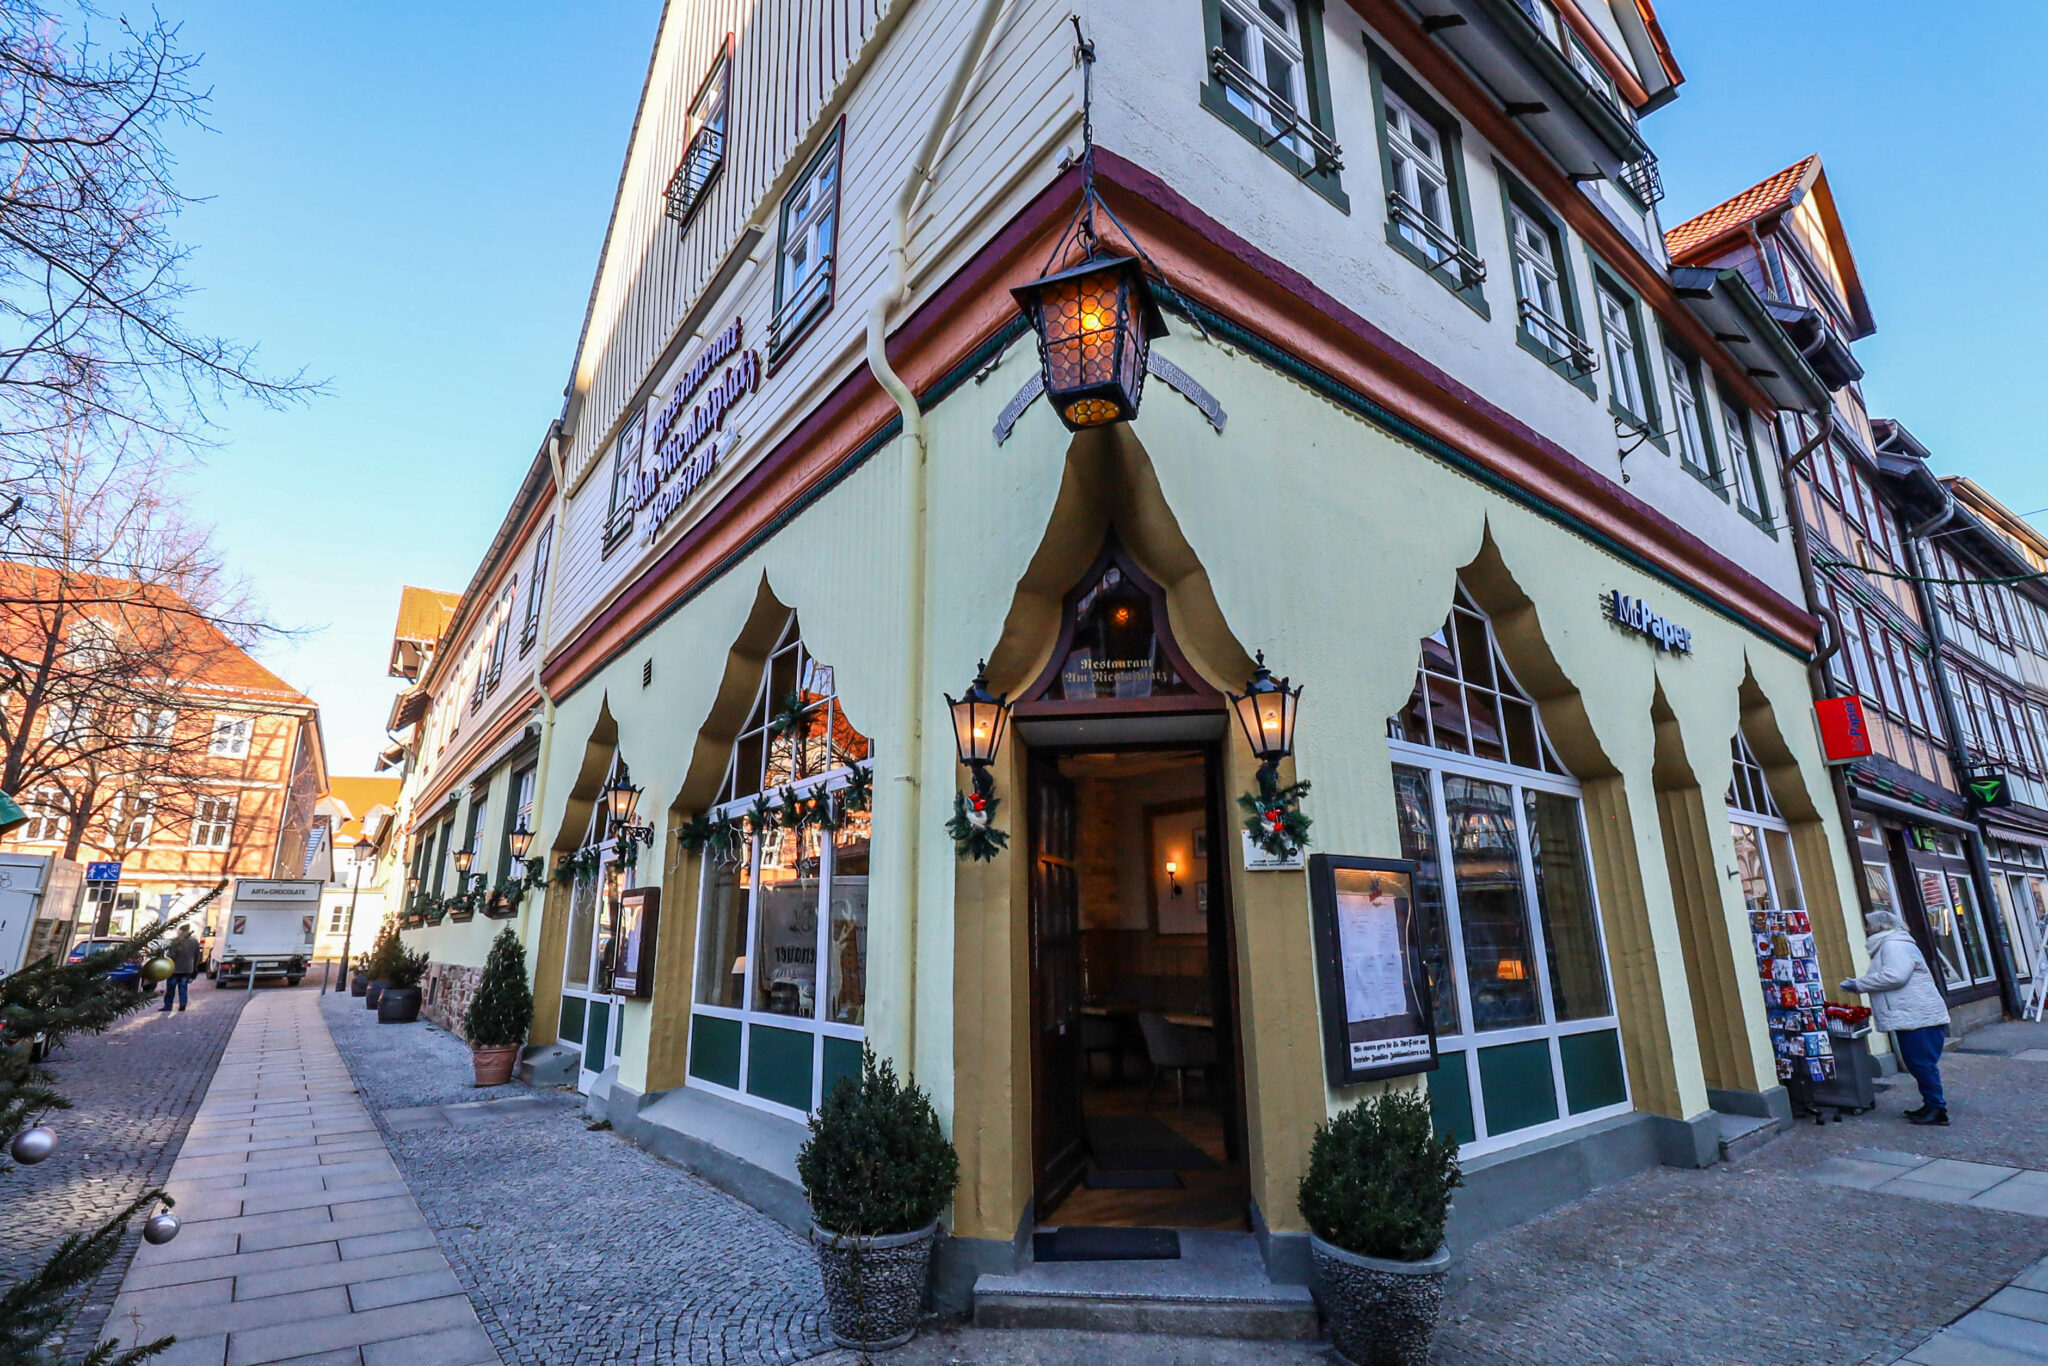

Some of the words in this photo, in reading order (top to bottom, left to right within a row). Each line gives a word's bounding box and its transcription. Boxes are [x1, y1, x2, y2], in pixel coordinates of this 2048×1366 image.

[652, 316, 742, 455] Restaurant
[632, 467, 659, 512] Am
[649, 442, 718, 545] Pension
[1611, 590, 1691, 652] McPaper
[1065, 672, 1087, 682] Am
[1080, 659, 1152, 669] Restaurant
